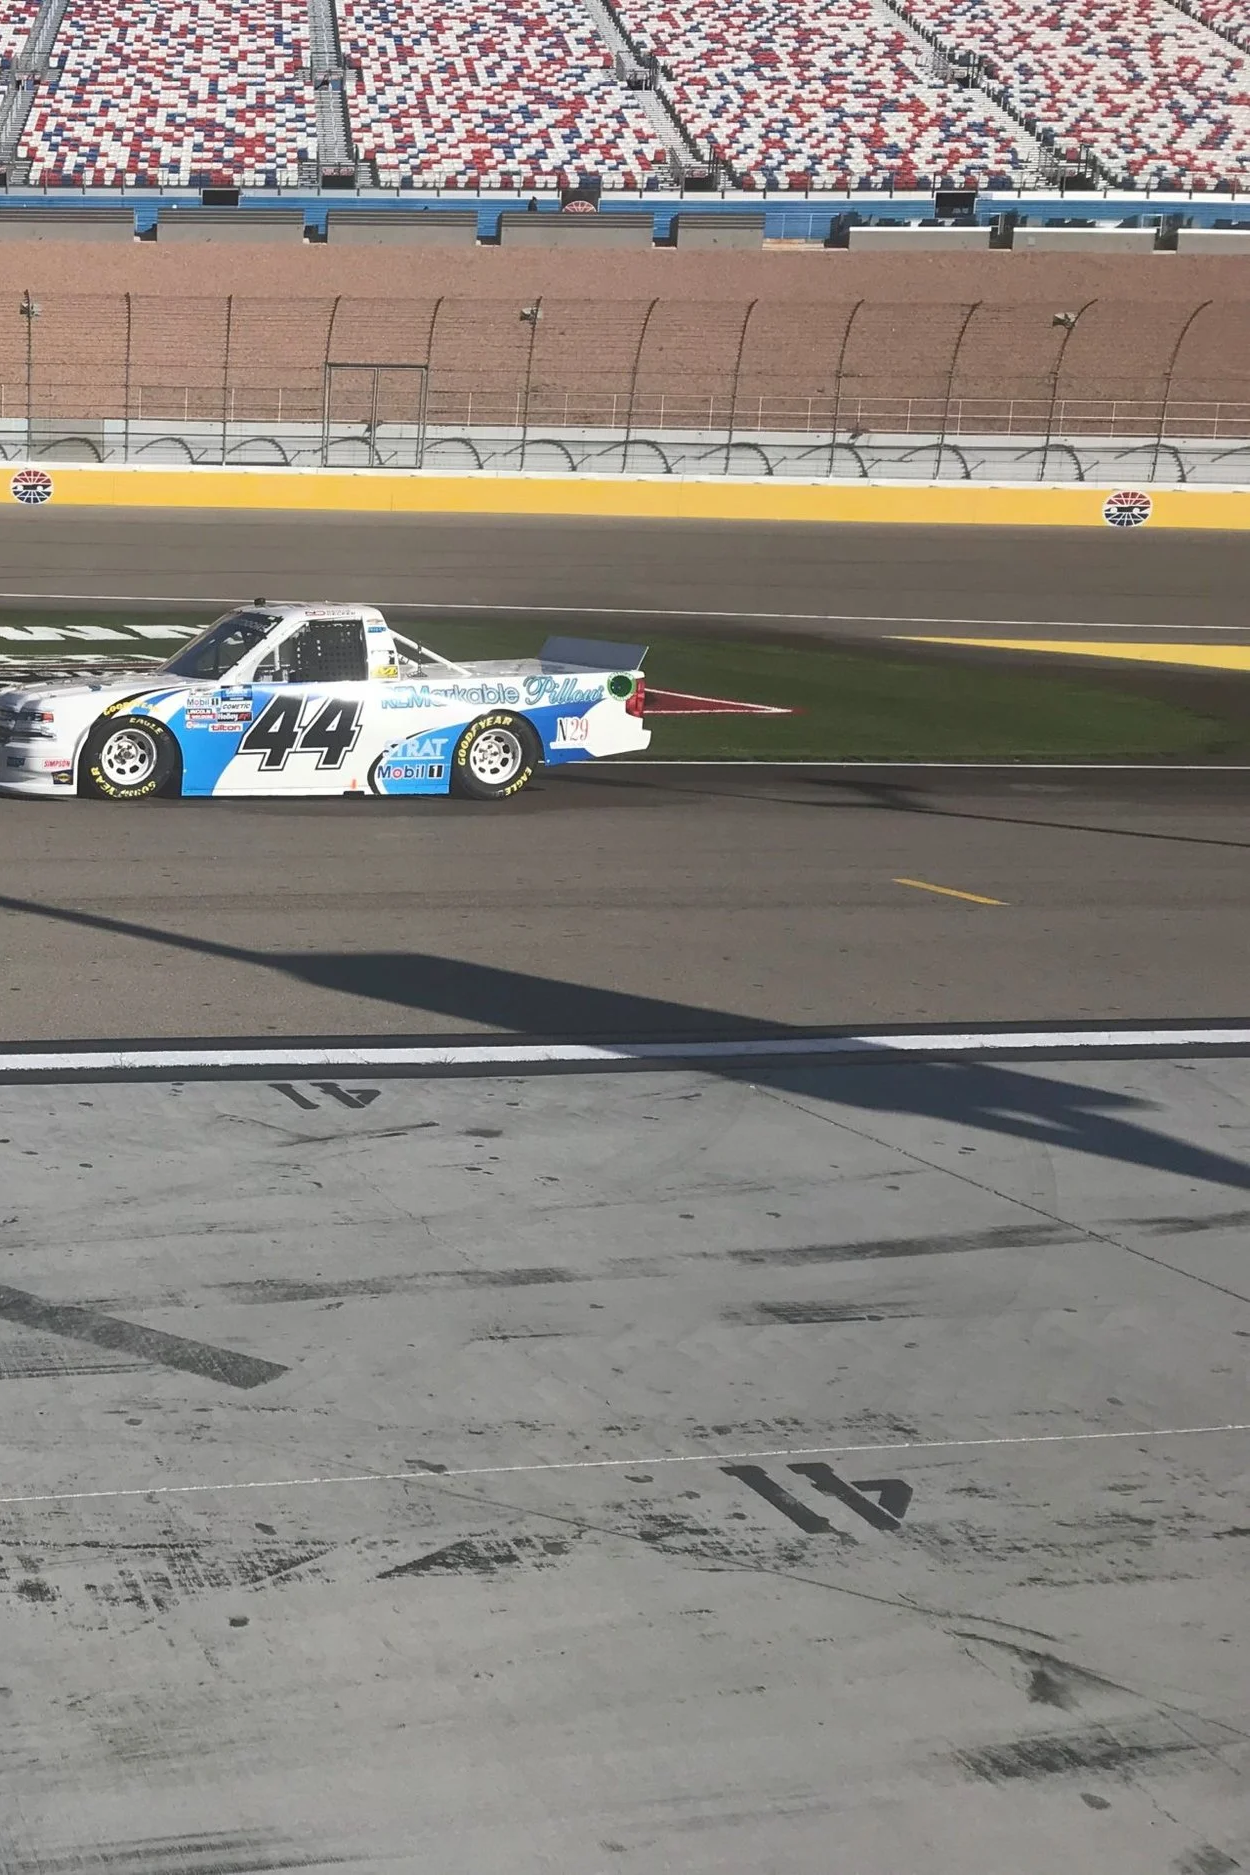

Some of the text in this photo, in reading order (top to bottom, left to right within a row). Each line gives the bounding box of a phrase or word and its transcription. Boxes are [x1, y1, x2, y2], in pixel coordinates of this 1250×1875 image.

[187, 697, 210, 706] Mobil
[129, 717, 164, 735] EAGLE
[237, 692, 364, 772] 44
[458, 715, 513, 766] GOODYEAR
[43, 759, 71, 768] SIMPSON
[377, 764, 425, 779] Mobil
[504, 766, 532, 797] EAGLE
